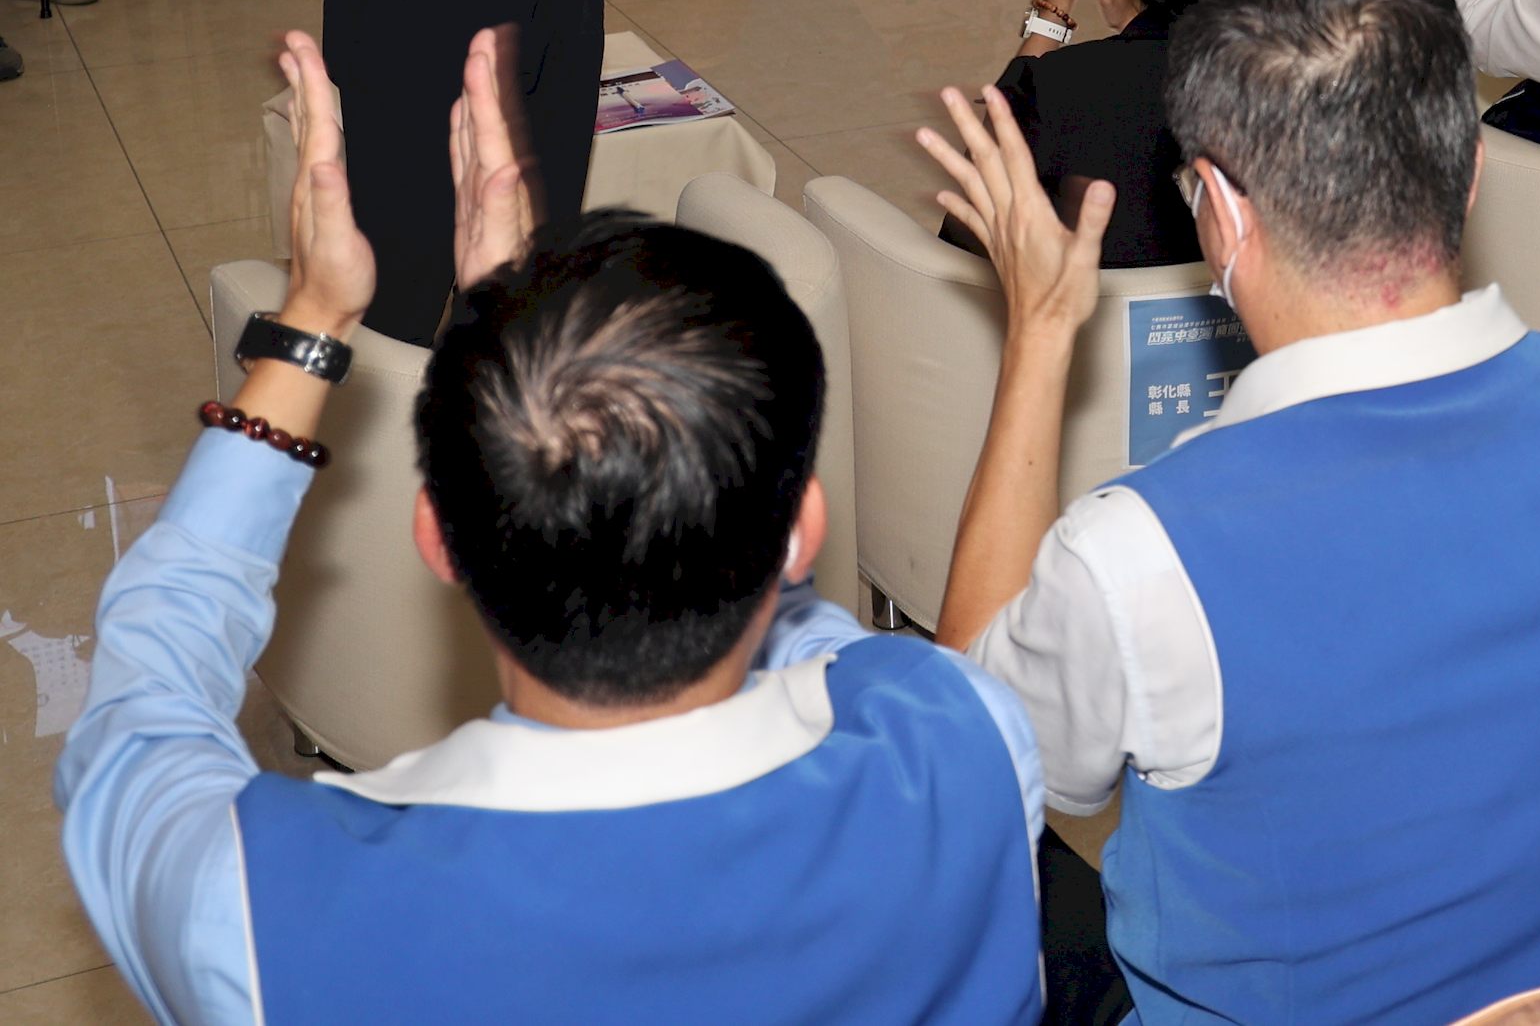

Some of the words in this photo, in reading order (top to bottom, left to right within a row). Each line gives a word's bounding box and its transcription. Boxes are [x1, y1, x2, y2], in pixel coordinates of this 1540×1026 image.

[1147, 383, 1192, 400] 彰化縣
[1148, 399, 1191, 416] 縣長
